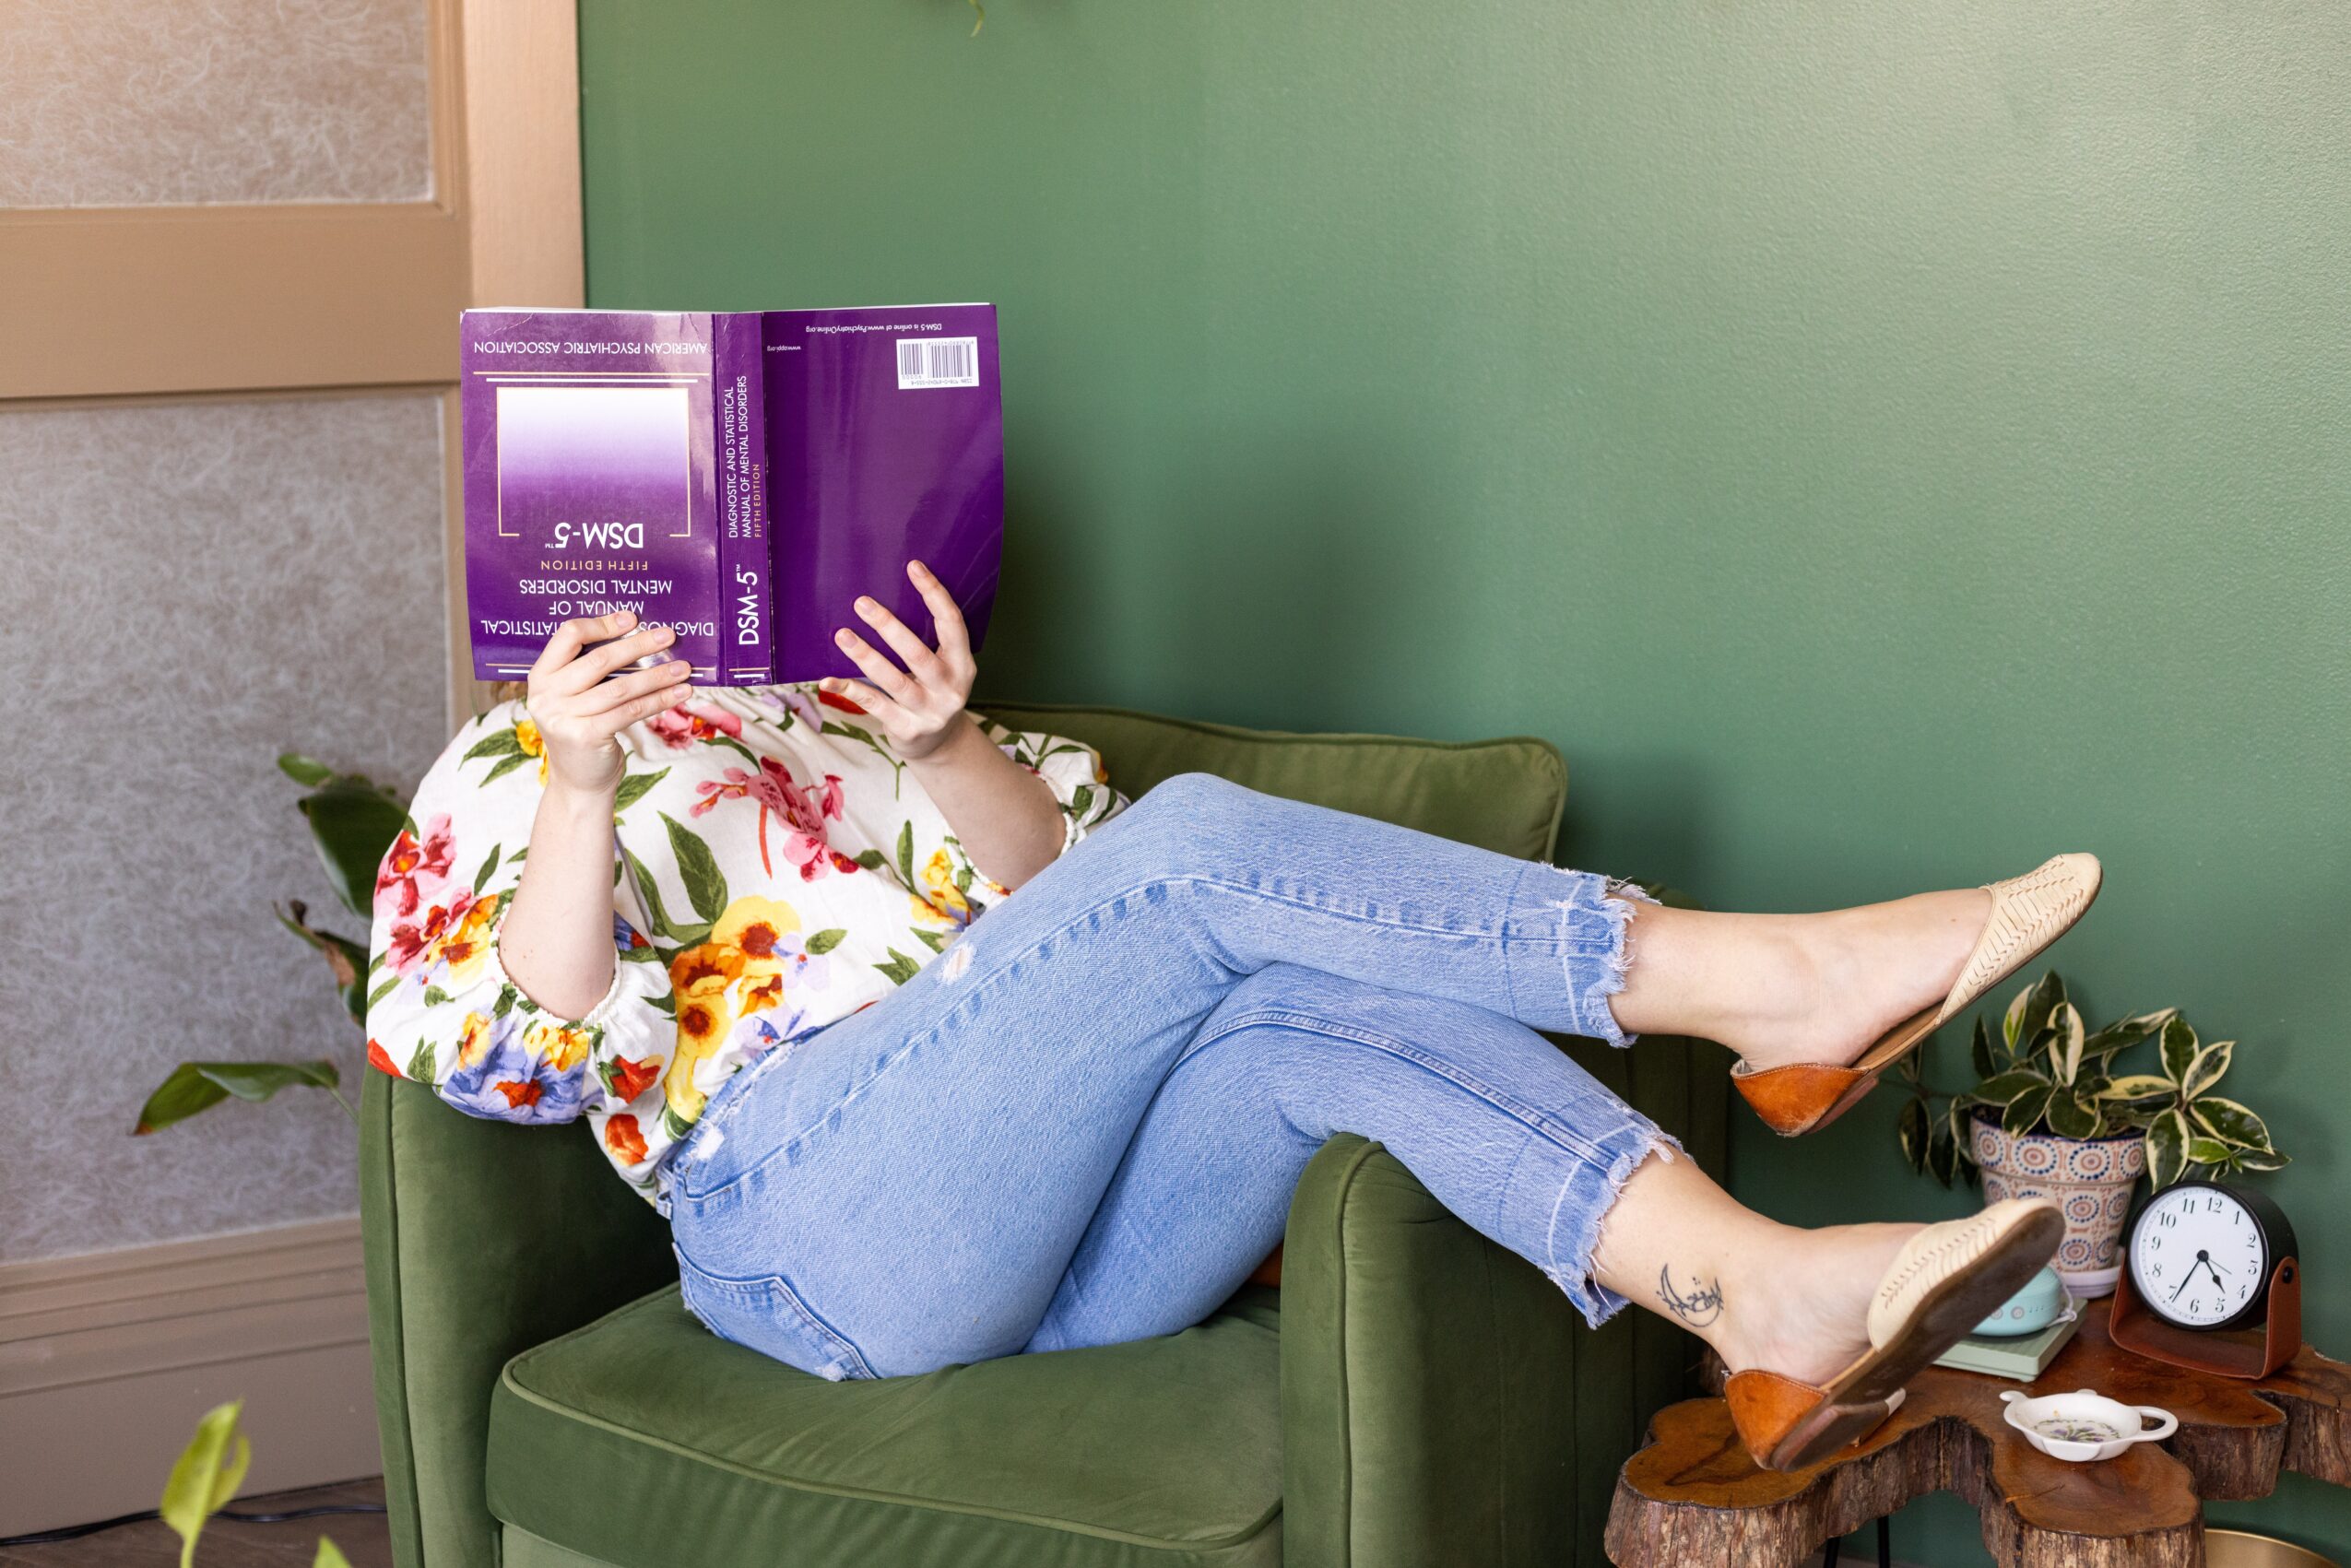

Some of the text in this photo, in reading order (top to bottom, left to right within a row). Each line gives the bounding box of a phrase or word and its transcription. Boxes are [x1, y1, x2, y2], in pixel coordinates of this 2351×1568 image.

[805, 324, 885, 334] www.PsychiatryOnline.org
[893, 324, 913, 332] online
[920, 323, 942, 332] DSM-5
[474, 341, 708, 355] AMERICAN PSYCHIATRIC ASSOCIATION
[724, 386, 738, 538] DIAGNOSTIC AND STATISTICAL
[737, 375, 751, 538] MANUAL OF MENTAL DISORDERS
[751, 463, 762, 537] FIFTH EDITION
[540, 560, 648, 571] FIFTH EDITION
[518, 579, 672, 595] MENTAL DISORDERS
[549, 600, 644, 615] MANUAL OF
[2182, 1197, 2196, 1214] 11
[2207, 1197, 2223, 1213] 12
[2159, 1211, 2177, 1228] 10
[2234, 1210, 2240, 1225] 1
[2151, 1235, 2161, 1251] 9
[2247, 1233, 2256, 1248] 2
[2152, 1263, 2162, 1278] 8
[2248, 1260, 2258, 1275] 3
[2168, 1285, 2178, 1301] 7
[2237, 1284, 2246, 1300] 4
[2190, 1299, 2200, 1314] 6
[2215, 1298, 2226, 1313] 5
